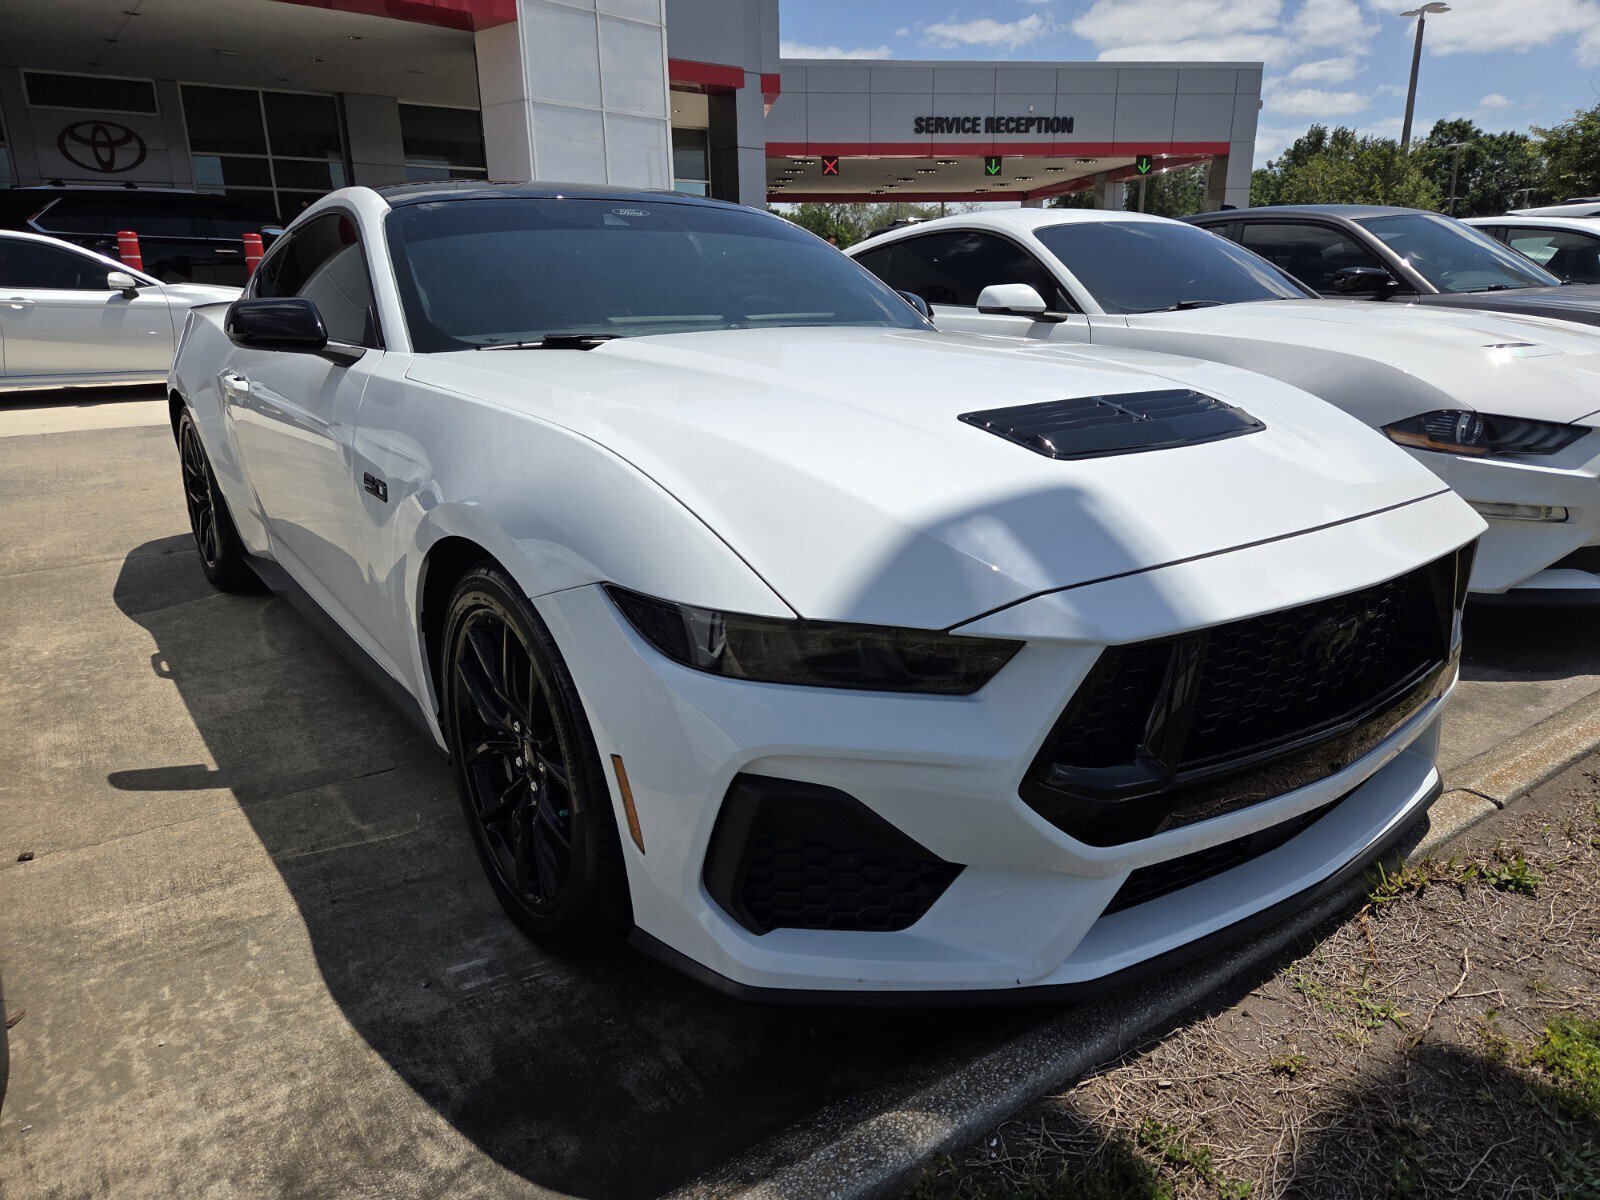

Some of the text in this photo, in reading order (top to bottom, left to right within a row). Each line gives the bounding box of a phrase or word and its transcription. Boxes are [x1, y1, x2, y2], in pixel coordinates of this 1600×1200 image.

[914, 116, 1074, 134] SERVICE RECEPTION
[618, 208, 645, 217] Ford
